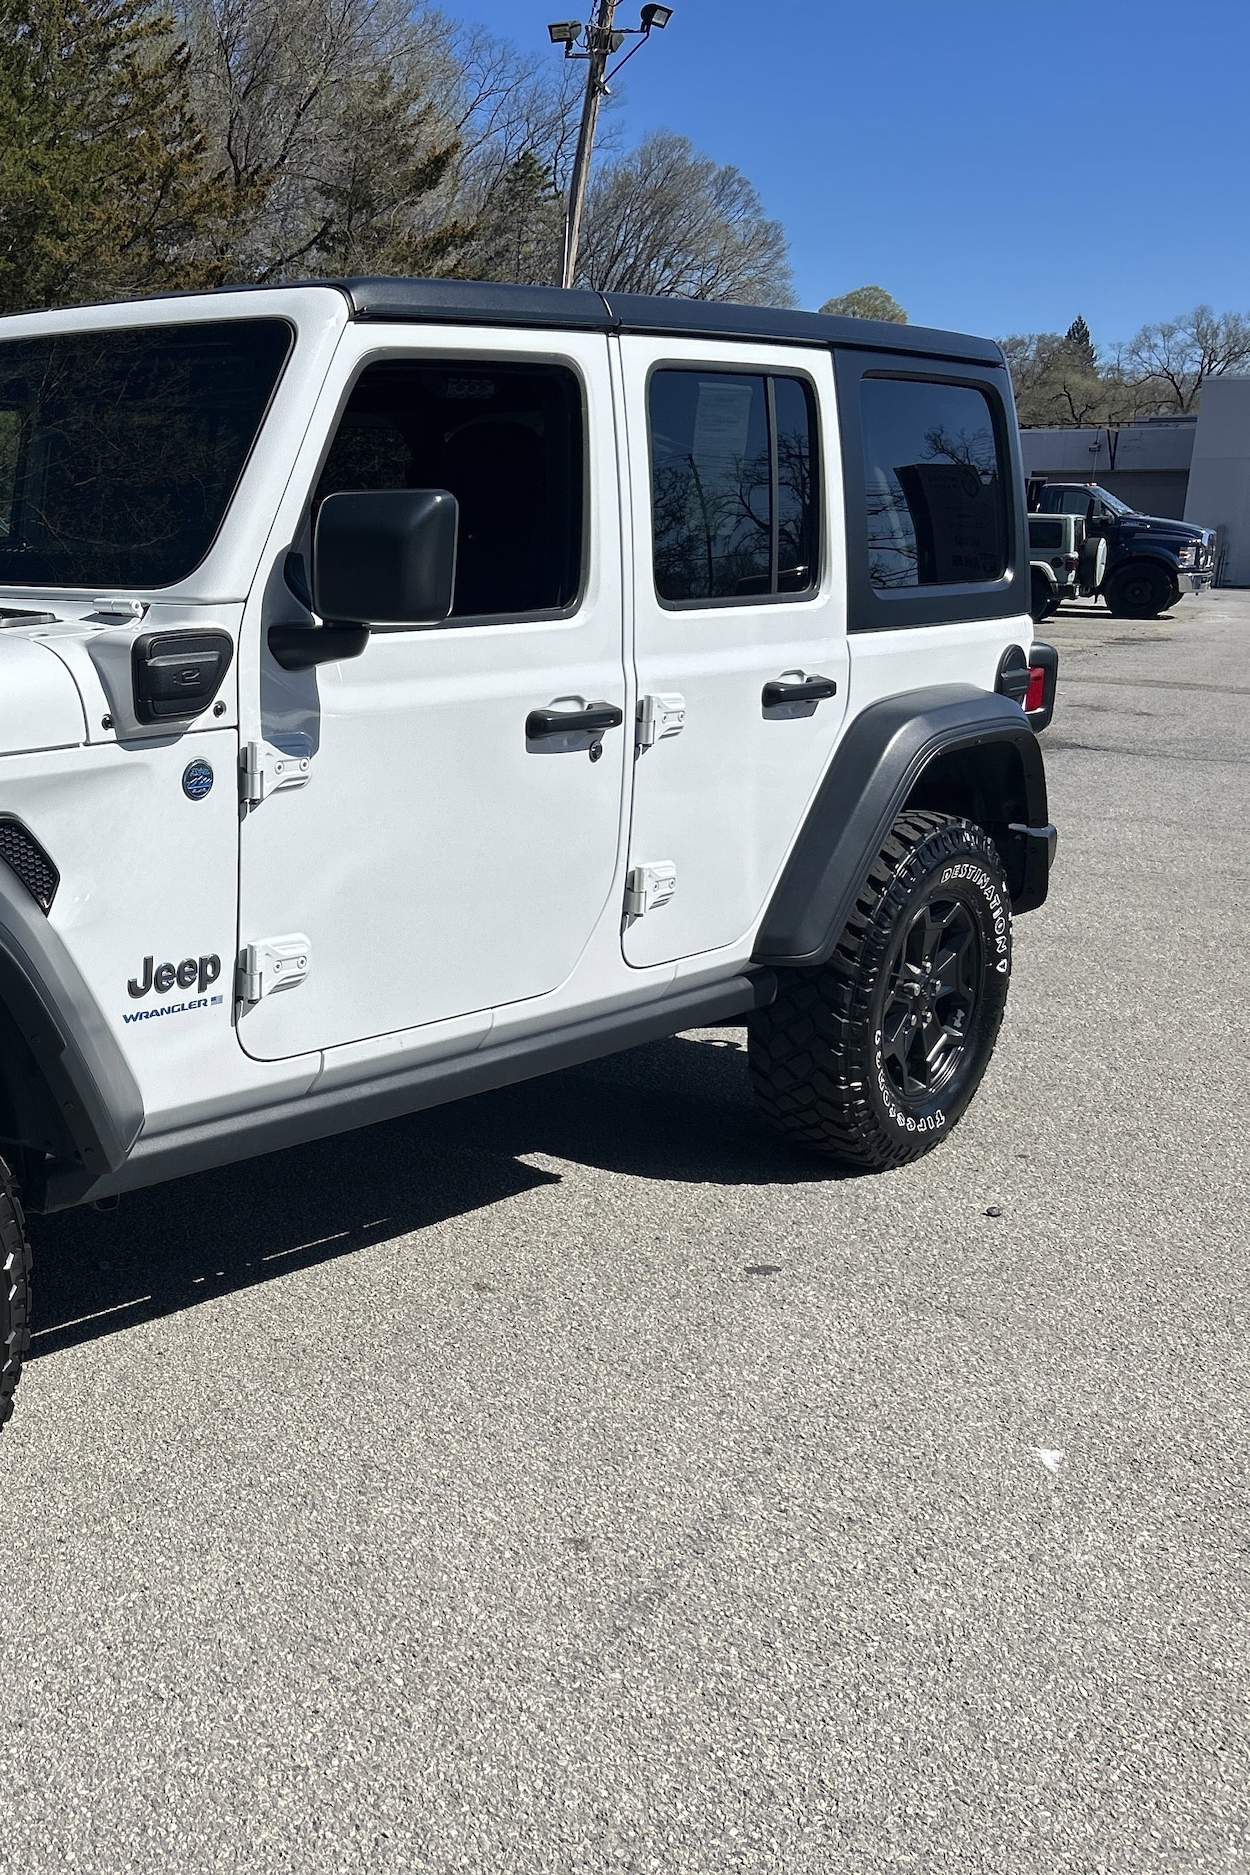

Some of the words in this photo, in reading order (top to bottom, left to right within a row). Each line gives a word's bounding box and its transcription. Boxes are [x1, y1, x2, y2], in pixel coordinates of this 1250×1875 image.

[941, 863, 1007, 953] DESTINATION
[127, 953, 221, 999] Jeep
[122, 998, 208, 1023] WRANGLER
